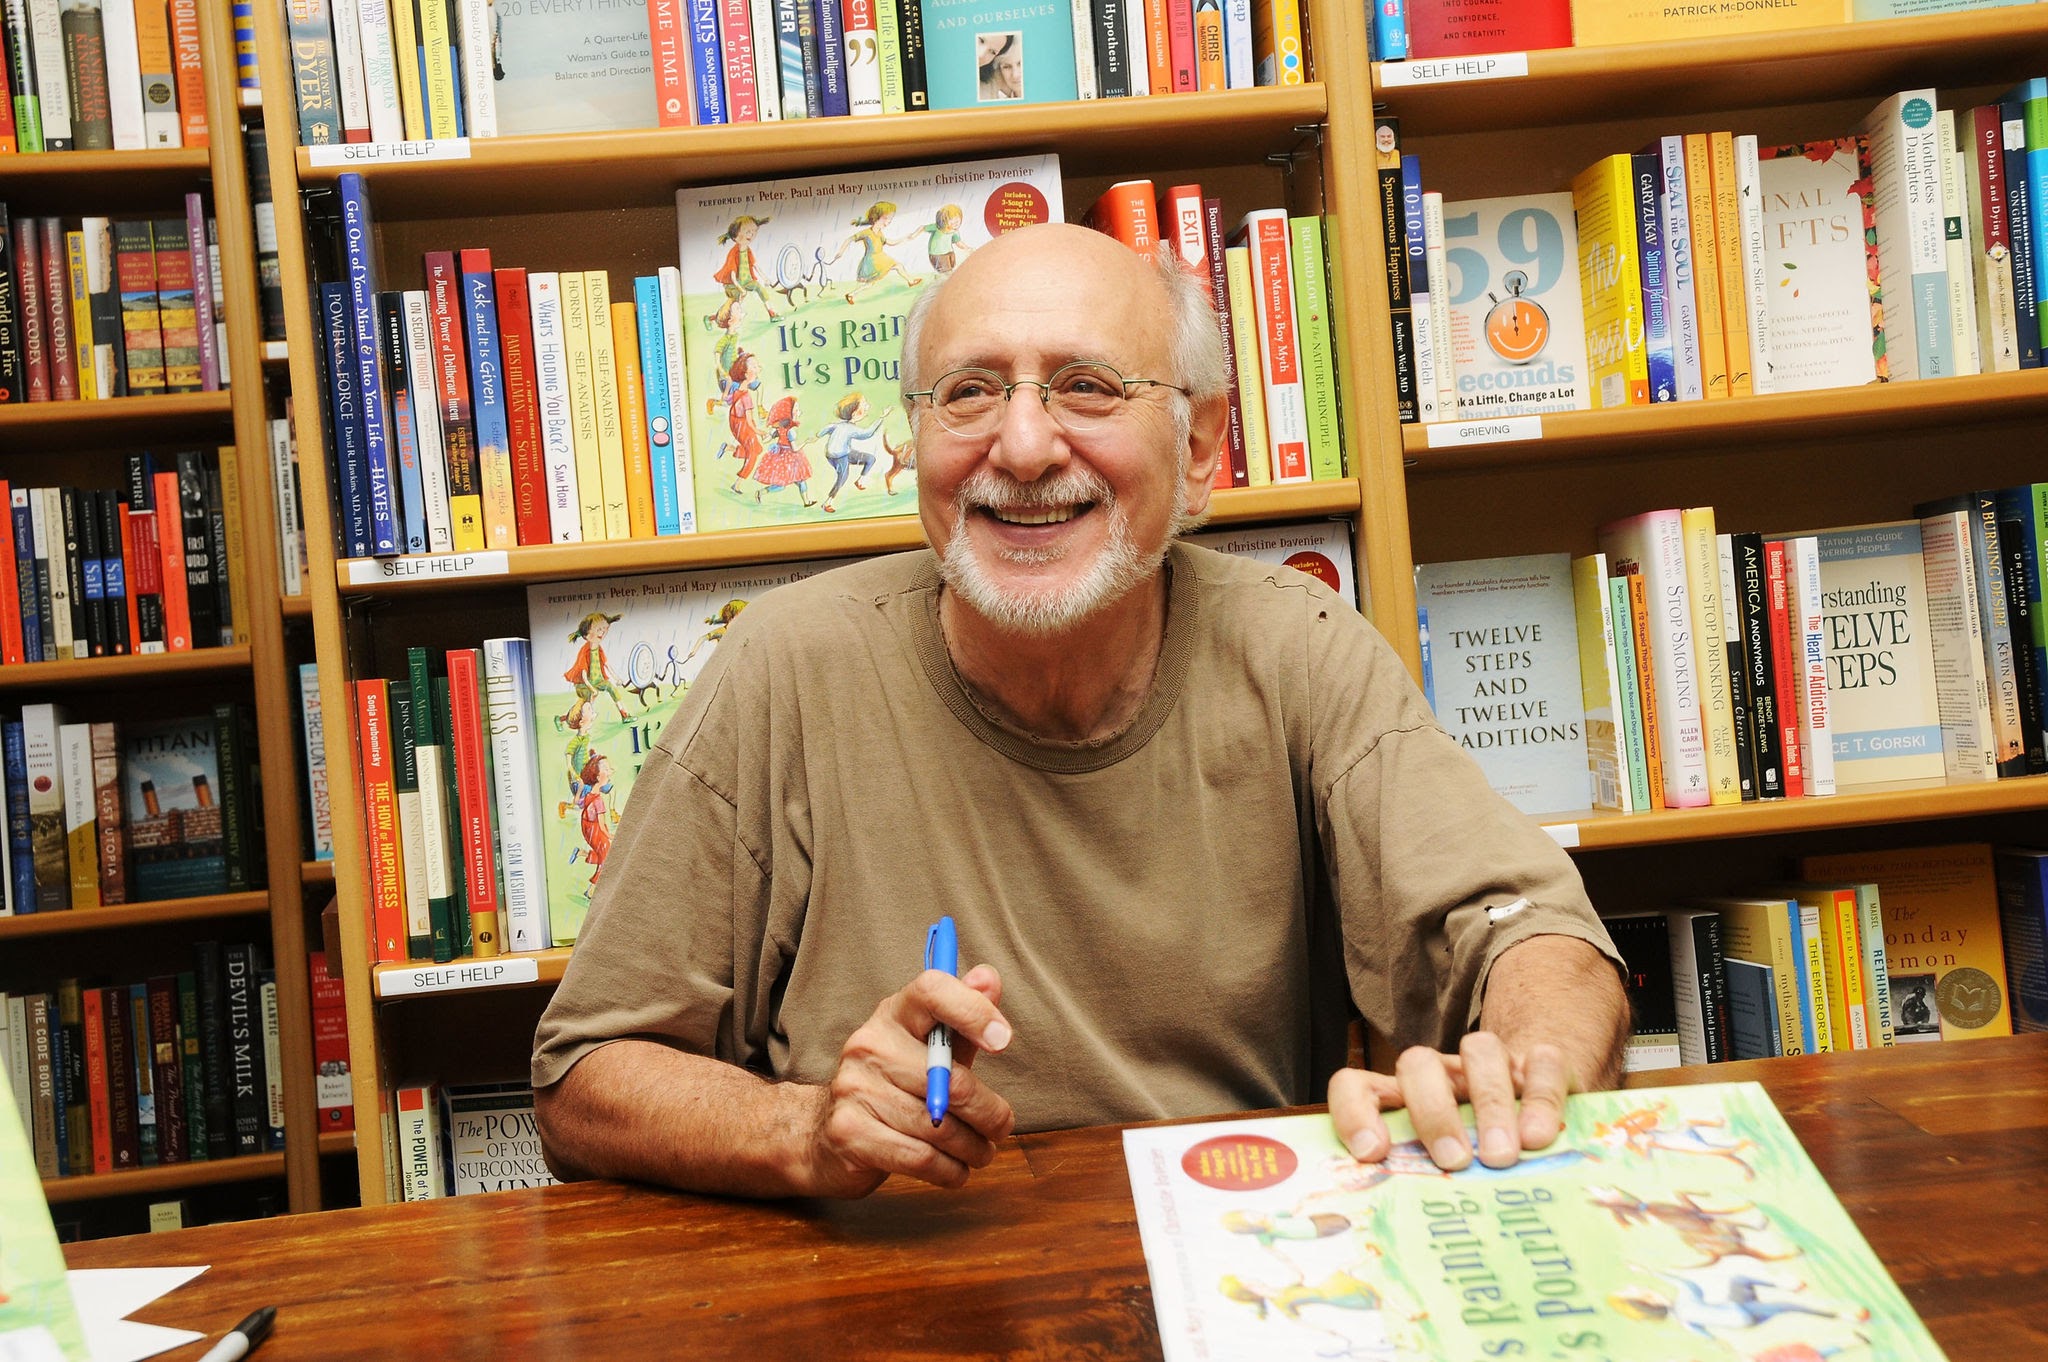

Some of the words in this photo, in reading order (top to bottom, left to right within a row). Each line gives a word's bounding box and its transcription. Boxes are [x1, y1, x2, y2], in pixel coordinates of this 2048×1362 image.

[470, 1, 482, 42] Beauty
[503, 4, 522, 16] 20
[530, 0, 647, 14] EVERYTHING
[937, 15, 967, 30] AND
[973, 4, 1055, 24] OURSELVES
[1448, 14, 1500, 22] CONFIDENCE,
[1664, 5, 1716, 17] PATRICK
[176, 0, 201, 70] COLLAPSE
[593, 32, 648, 45] Quarter-Life
[1105, 4, 1117, 73] Hypothesis
[1208, 25, 1219, 62] CHRIS
[1463, 30, 1505, 39] CREATIVITY
[298, 42, 320, 111] DYER
[555, 71, 586, 80] Balance
[610, 66, 651, 76] Direction
[567, 53, 607, 63] Woman's
[611, 50, 636, 60] Guide
[663, 38, 678, 86] TIME
[740, 45, 753, 84] PLACE
[823, 42, 837, 94] Intelligence
[1413, 64, 1449, 79] SELF
[1456, 60, 1496, 75] HELP
[344, 145, 385, 159] SELF
[392, 143, 435, 156] HELP
[1904, 136, 1918, 203] Daughters
[1922, 132, 1934, 204] Motherless
[759, 190, 788, 201] Peter,
[791, 187, 813, 199] Paul
[816, 185, 834, 196] and
[838, 183, 863, 195] Mary
[867, 180, 919, 192] ILLUSTRATED
[935, 171, 985, 185] Christine
[988, 168, 1034, 179] Davenier
[1666, 166, 1683, 215] SEAT
[1987, 150, 1995, 180] Death
[1991, 206, 1999, 237] Dying
[347, 201, 358, 224] Get
[1133, 208, 1148, 249] FIRE
[1183, 210, 1199, 246] EXIT
[350, 228, 361, 254] Out
[1302, 227, 1313, 273] RICHARD
[1385, 177, 1397, 243] Spontaneous
[1391, 247, 1402, 300] Happiness
[1648, 251, 1662, 287] Spiritual
[1672, 239, 1691, 289] SOUL
[2014, 252, 2026, 310] GRIEVING
[23, 269, 39, 316] ALEPPO
[352, 272, 366, 304] Your
[473, 280, 490, 308] Ask
[1209, 207, 1220, 260] Boundaries
[1220, 311, 1232, 375] Relationships
[357, 308, 373, 342] Mind
[413, 317, 424, 350] SECOND
[538, 299, 555, 337] WHAT'S
[1271, 275, 1282, 320] Mama's
[1279, 347, 1287, 372] Myth
[1653, 289, 1666, 338] Partnership
[1927, 311, 1938, 348] Edelman
[26, 320, 40, 365] CODEX
[329, 294, 346, 346] POWER
[338, 373, 353, 420] FORCE
[389, 316, 401, 367] HENDRICKS
[436, 279, 447, 316] Amazing
[443, 354, 456, 396] Deliberate
[778, 321, 826, 352] It's
[4, 349, 15, 376] Fire
[362, 360, 373, 386] Into
[416, 353, 429, 391] THOUGHT
[542, 344, 557, 389] HOLDING
[568, 280, 582, 330] HORNEY
[575, 351, 591, 440] SELF-ANALYSIS
[785, 358, 830, 389] It's
[1312, 343, 1324, 387] NATURE
[480, 362, 496, 405] Given
[511, 365, 525, 411] HILLMAN
[1509, 392, 1547, 404] Change
[1558, 388, 1574, 398] Lot
[365, 391, 377, 419] Your
[547, 394, 561, 415] YOU
[1317, 389, 1330, 447] PRINCIPLE
[368, 423, 382, 448] Life
[398, 417, 409, 435] BIG
[550, 419, 568, 453] BACK?
[1460, 424, 1510, 438] GRIEVING
[401, 439, 413, 468] LEAP
[517, 440, 530, 480] SOUL'S
[555, 464, 567, 483] SAM
[131, 457, 144, 508] EMPIRE
[372, 468, 389, 521] HAYES
[520, 483, 531, 517] CODE
[555, 486, 568, 508] HORN
[212, 514, 226, 580] ENDURANCE
[1228, 540, 1277, 553] Christine
[1281, 537, 1325, 548] Davenier
[1981, 512, 2000, 575] BURNING
[384, 561, 424, 576] SELF
[431, 558, 473, 573] HELP
[1745, 546, 1760, 615] AMERICA
[2014, 554, 2026, 616] DRINKING
[19, 560, 37, 618] BANANA
[1667, 585, 1684, 627] STOP
[1990, 580, 2006, 626] DESIRE
[1449, 624, 1542, 649] TWELVE
[1751, 618, 1764, 686] ANONYMOUS
[1807, 634, 1822, 662] Heart
[1466, 651, 1532, 673] STEPS
[1671, 631, 1691, 709] SMOKING
[1706, 634, 1725, 711] DRINKING
[487, 675, 518, 734] BLISS
[1474, 677, 1527, 698] AND
[1809, 676, 1825, 728] Addiction
[2002, 679, 2015, 725] GRIFFIN
[1456, 700, 1548, 724] TWELVE
[1736, 707, 1745, 747] Cheever
[1756, 696, 1767, 753] DENIZET-LEWIS
[135, 730, 210, 752] TITAN
[368, 718, 380, 767] Lyubomirsky
[1870, 736, 1926, 750] GORSKI
[501, 740, 514, 816] EXPERIMENT
[102, 789, 114, 822] LAST
[103, 827, 116, 876] UTOPIA
[475, 845, 485, 897] MENOUNOS
[380, 843, 397, 908] HAPPINESS
[414, 970, 455, 987] SELF
[461, 966, 503, 983] HELP
[1874, 950, 1890, 1028] RETHINKING
[229, 962, 247, 1047] DEVIL'S
[266, 987, 277, 1036] ATLANTIC
[1813, 972, 1826, 1040] EMPEROR'S
[36, 1030, 48, 1063] CODE
[1709, 1026, 1717, 1060] Jamison
[39, 1068, 51, 1097] BOOK
[235, 1049, 252, 1097] MILK
[458, 1122, 483, 1138] The
[413, 1137, 428, 1178] POWER
[1501, 1186, 1594, 1321] pouring
